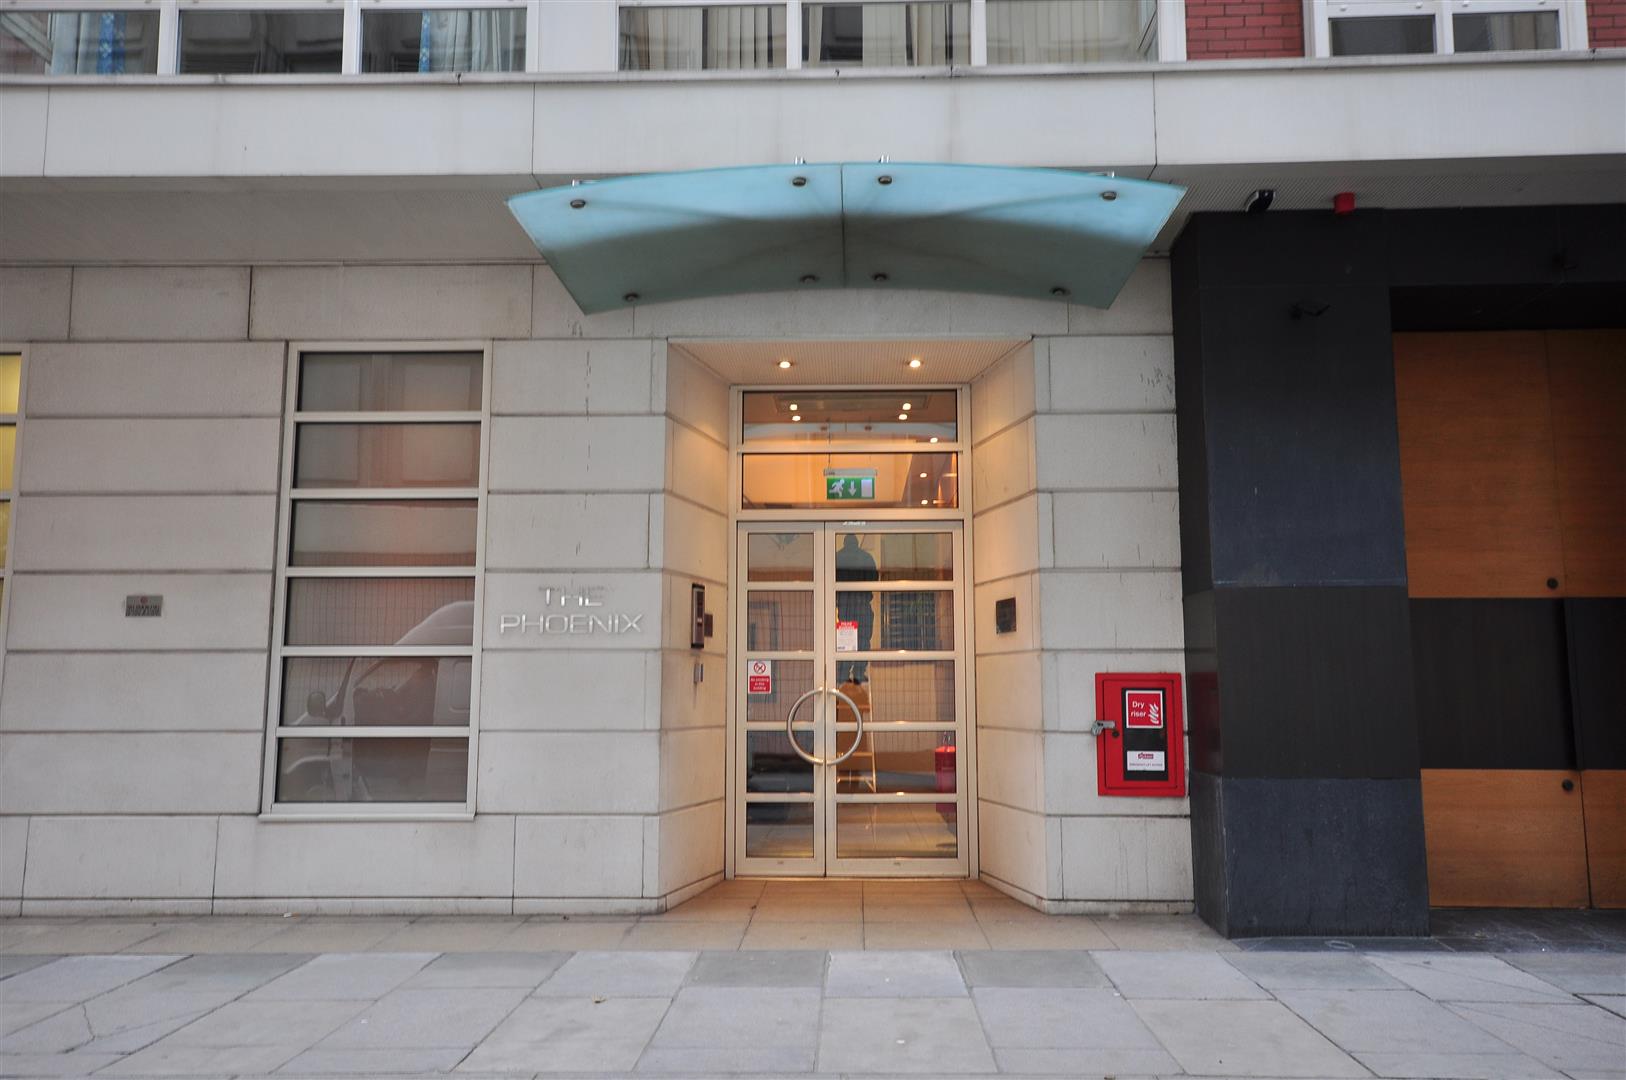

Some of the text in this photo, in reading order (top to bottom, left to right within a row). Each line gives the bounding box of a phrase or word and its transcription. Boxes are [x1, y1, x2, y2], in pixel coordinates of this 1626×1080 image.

[539, 587, 604, 607] THE
[500, 613, 643, 634] PHOENIX
[1132, 701, 1145, 709] Dry
[1130, 710, 1147, 718] riser
